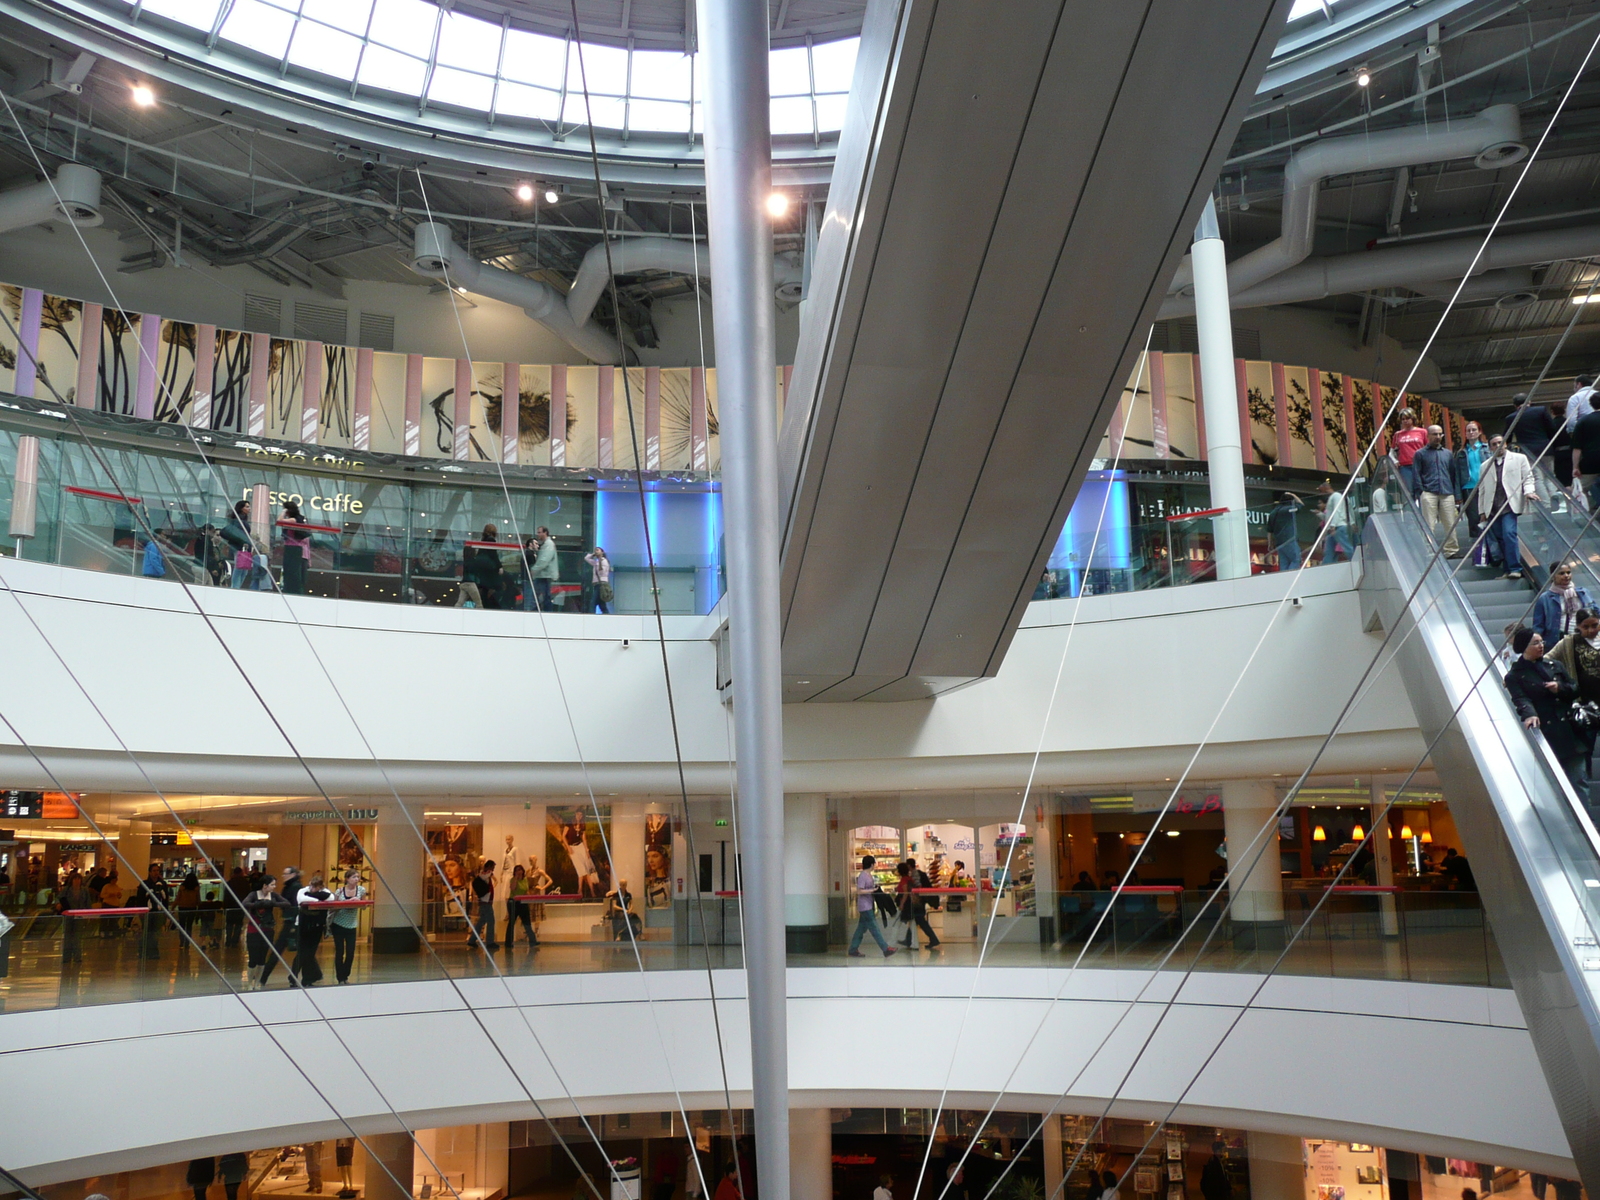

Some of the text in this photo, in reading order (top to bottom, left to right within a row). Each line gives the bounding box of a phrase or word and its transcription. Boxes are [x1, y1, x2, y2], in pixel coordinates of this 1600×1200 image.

[243, 487, 363, 514] rsso caffe
[1245, 510, 1271, 524] RUIT
